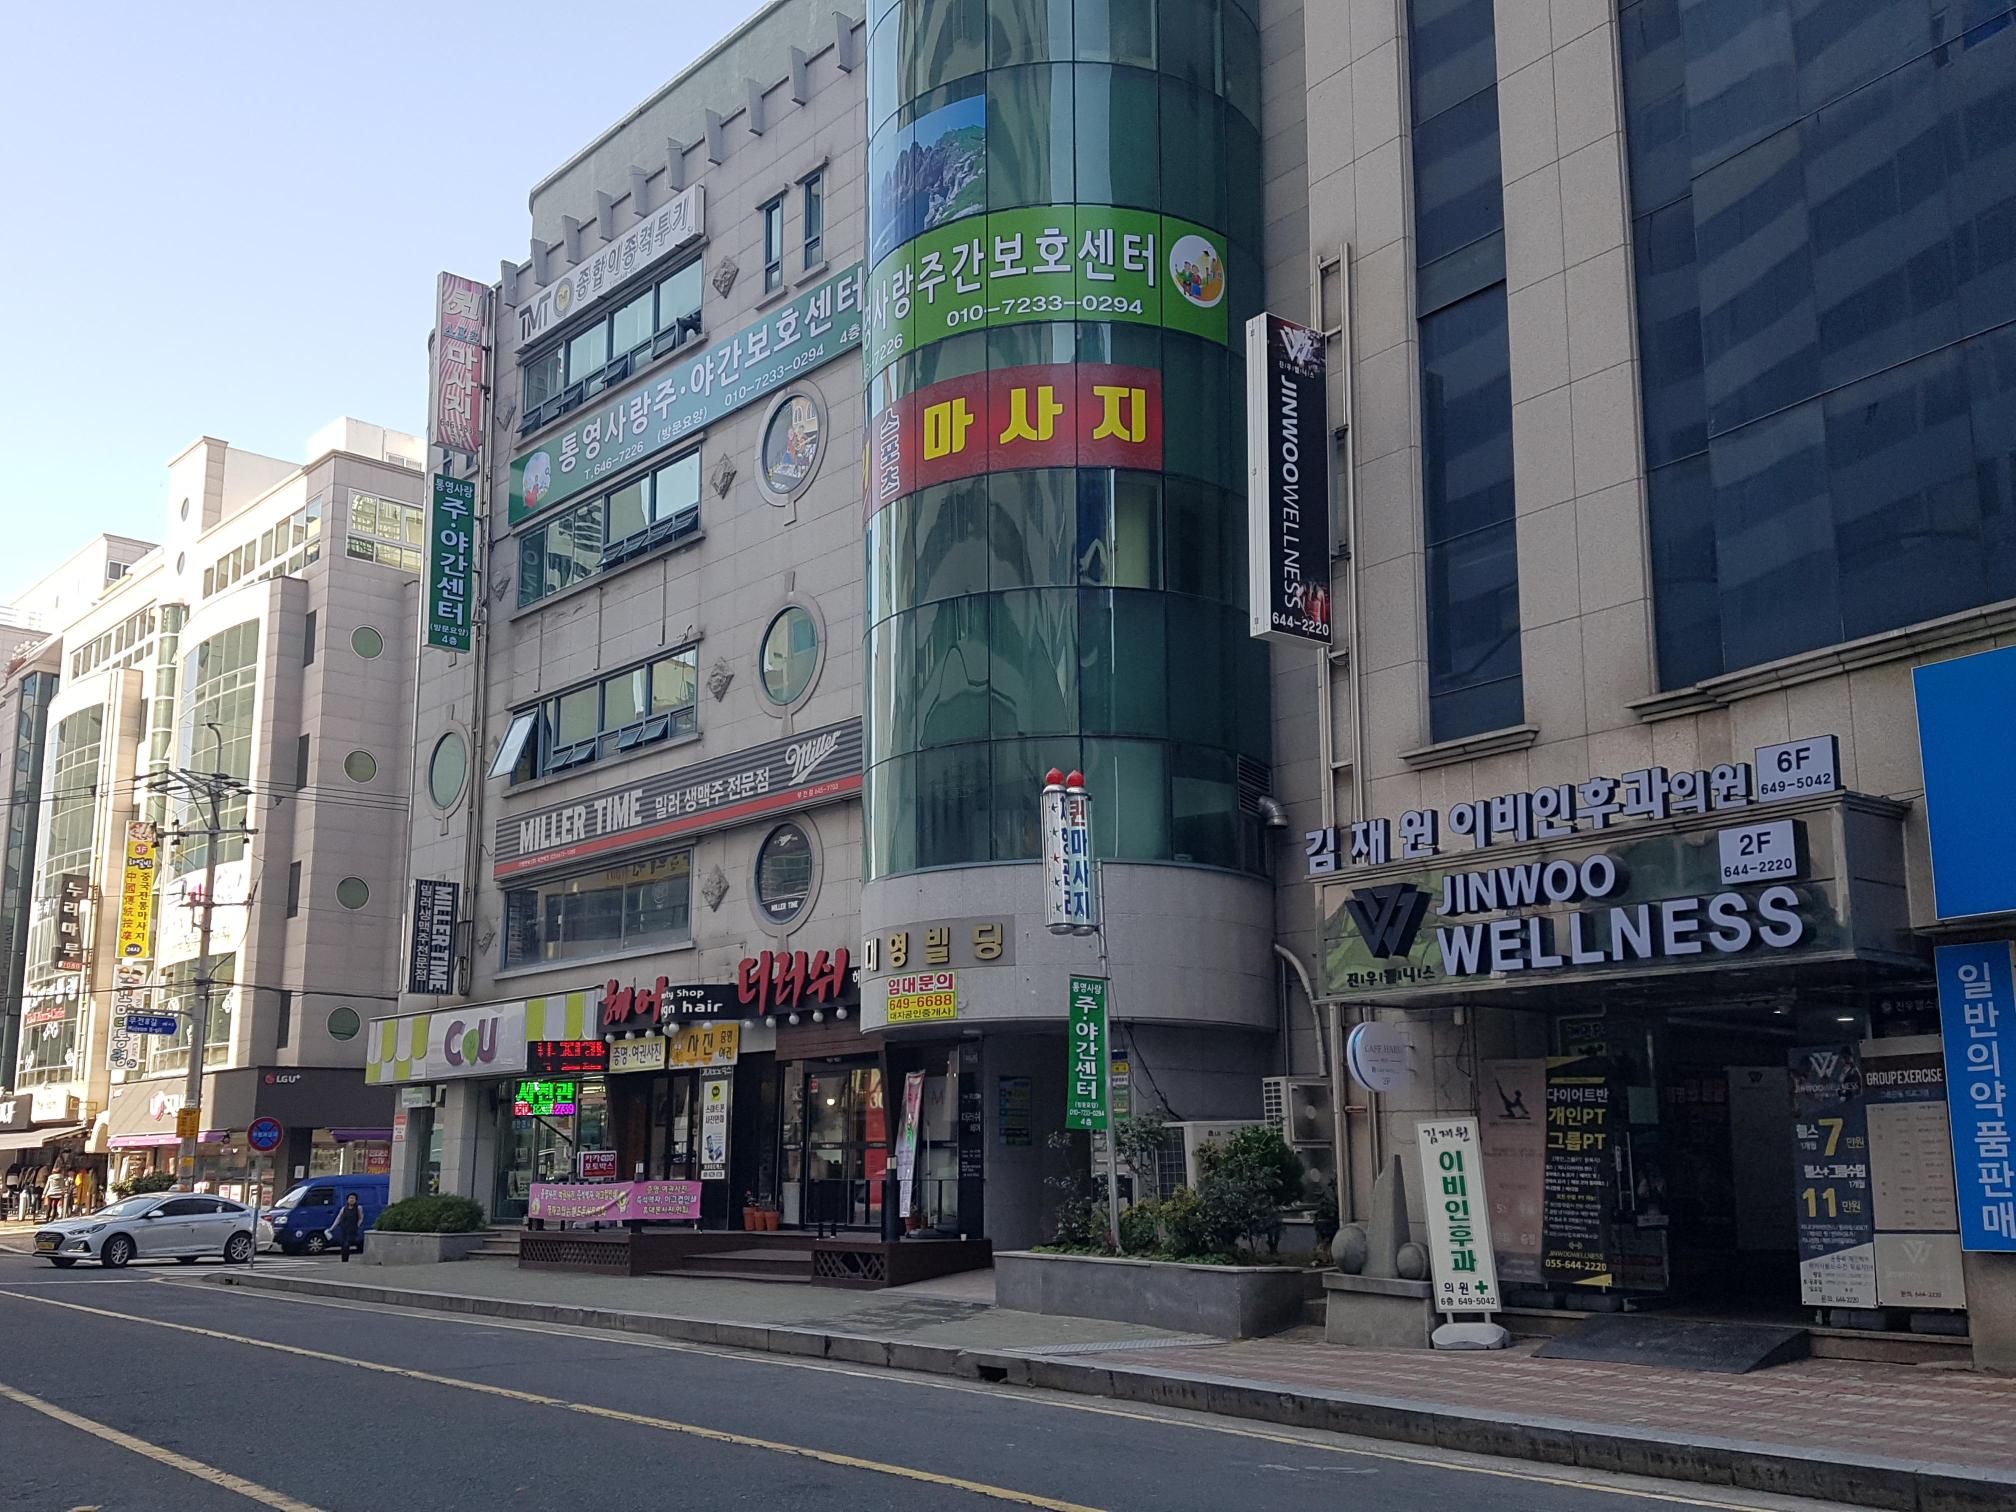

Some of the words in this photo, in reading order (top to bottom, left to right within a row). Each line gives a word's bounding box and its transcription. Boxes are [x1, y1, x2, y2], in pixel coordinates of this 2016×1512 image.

[946, 294, 1143, 327] 010-7233-0294
[446, 347, 479, 421] 마사지
[724, 344, 824, 406] 010-7233-0294
[924, 385, 1147, 461] 마사지
[1272, 611, 1329, 636] 644-2220
[785, 730, 842, 786] Miller
[1777, 747, 1811, 773] 6F
[655, 794, 680, 820] 밀러
[684, 780, 724, 814] 생맥주
[727, 767, 769, 800] 전문점
[1761, 773, 1831, 795] 649-5042
[519, 804, 586, 855] MILLER
[593, 788, 643, 835] TIME
[1305, 809, 1438, 874] 김재원
[1449, 762, 1753, 848] 이비인후과의원
[1740, 831, 1771, 856] 2F
[1071, 829, 1090, 919] 마사지
[1724, 857, 1792, 878] 644-2220
[1436, 854, 1617, 916] JINWOO
[62, 881, 84, 958] 누리마루
[431, 886, 453, 947] MILLER
[1437, 885, 1805, 976] WELLNESS
[428, 950, 449, 991] TIME
[888, 973, 954, 996] 임대문의
[676, 988, 704, 999] Shop
[682, 1000, 723, 1014] hair
[889, 994, 952, 1011] 649-6688
[444, 1017, 498, 1067] CU
[516, 1081, 575, 1105] 사진관
[1866, 1071, 1897, 1086] GROUP
[1897, 1068, 1944, 1084] EXERCISE
[1546, 1087, 1610, 1103] 다이어트반
[1958, 962, 2016, 1241] 일반의약품판매
[1548, 1106, 1607, 1126] 개인PT
[1547, 1131, 1607, 1152] 그룹PT
[1819, 1118, 1844, 1156] 7
[1439, 1150, 1478, 1273] 이비인후과
[1802, 1187, 1837, 1218] 11
[1545, 1259, 1607, 1272] 055-644-2220
[1443, 1282, 1470, 1296] 의원
